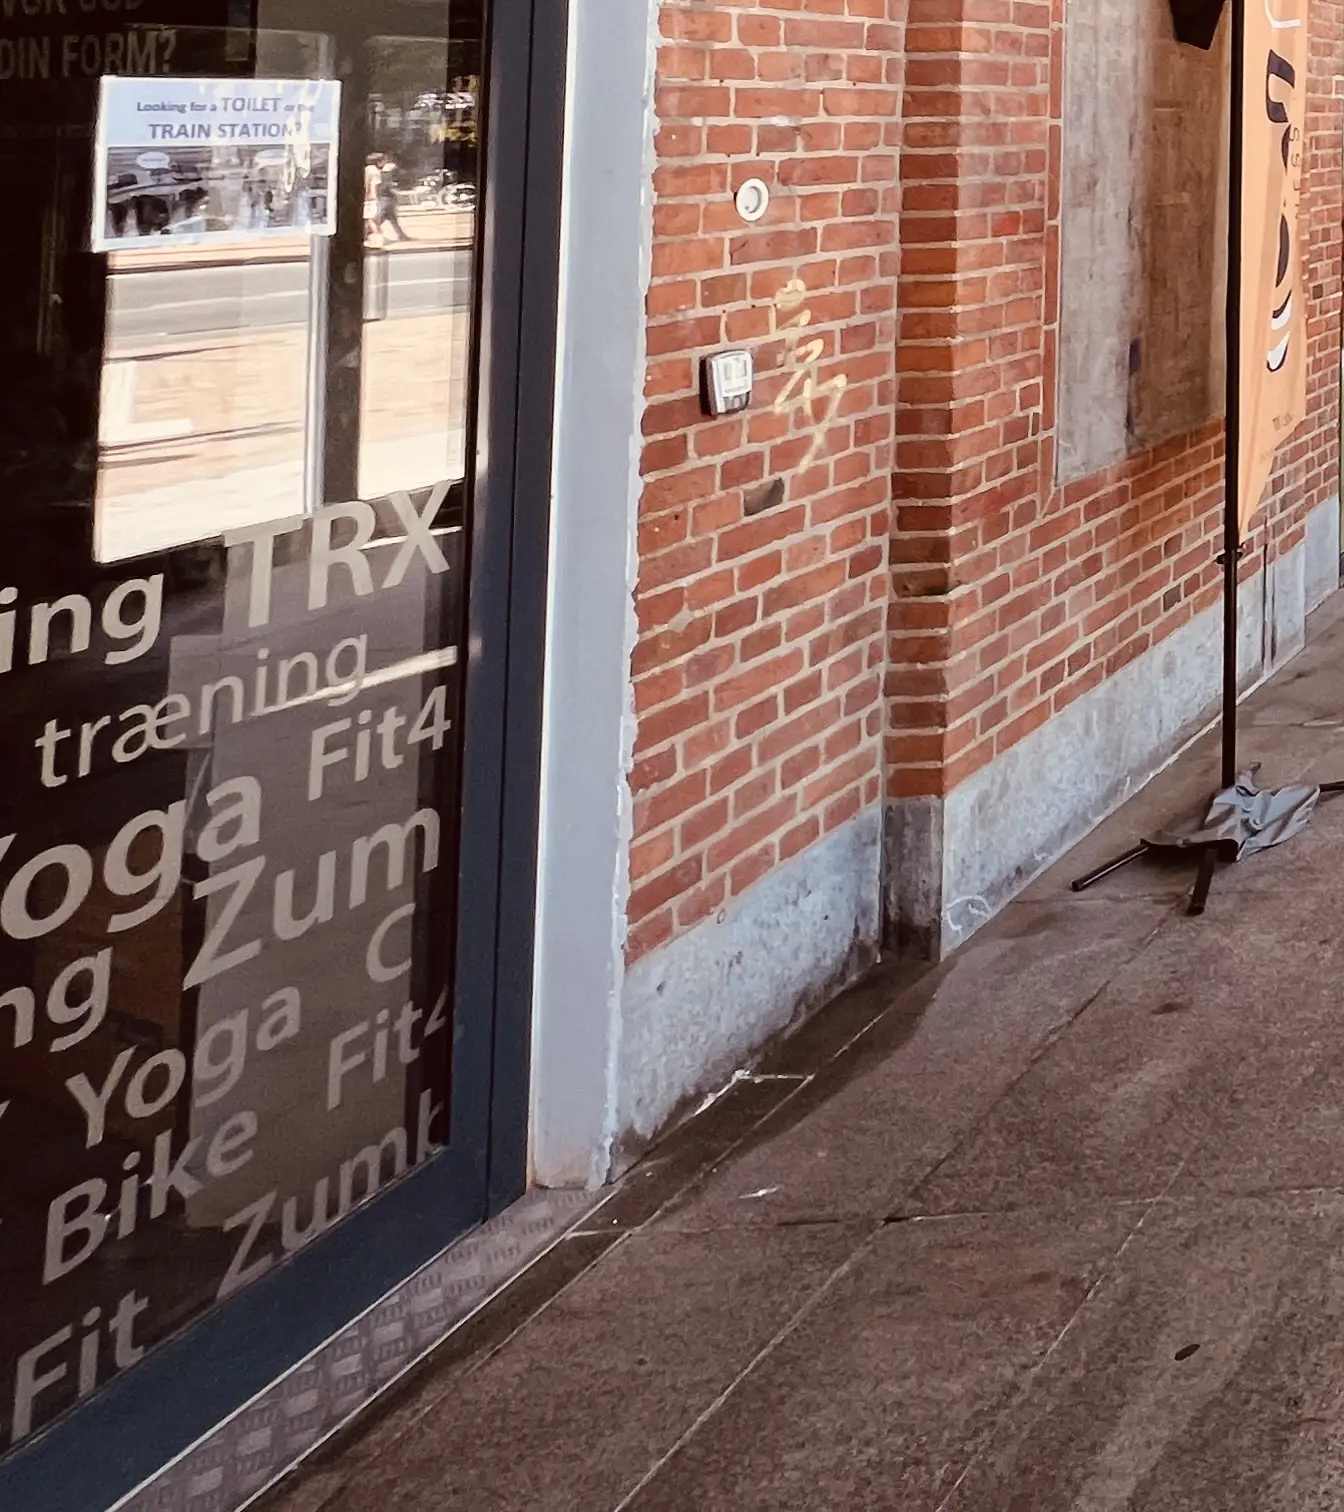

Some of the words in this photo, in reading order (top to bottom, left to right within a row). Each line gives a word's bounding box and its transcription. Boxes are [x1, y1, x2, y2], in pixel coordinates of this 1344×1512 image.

[61, 29, 177, 80] FORM?
[136, 100, 188, 114] Looking
[189, 100, 208, 113] for
[209, 104, 218, 112] a
[220, 97, 282, 113] TOILET
[149, 122, 212, 139] TRAIN
[223, 479, 450, 628] TRX
[35, 632, 368, 787] træning
[308, 685, 451, 801] Fit4
[0, 775, 262, 940] oga
[66, 987, 301, 1149] Yoga
[42, 1110, 258, 1285] Bike
[10, 1289, 149, 1444] Fit
